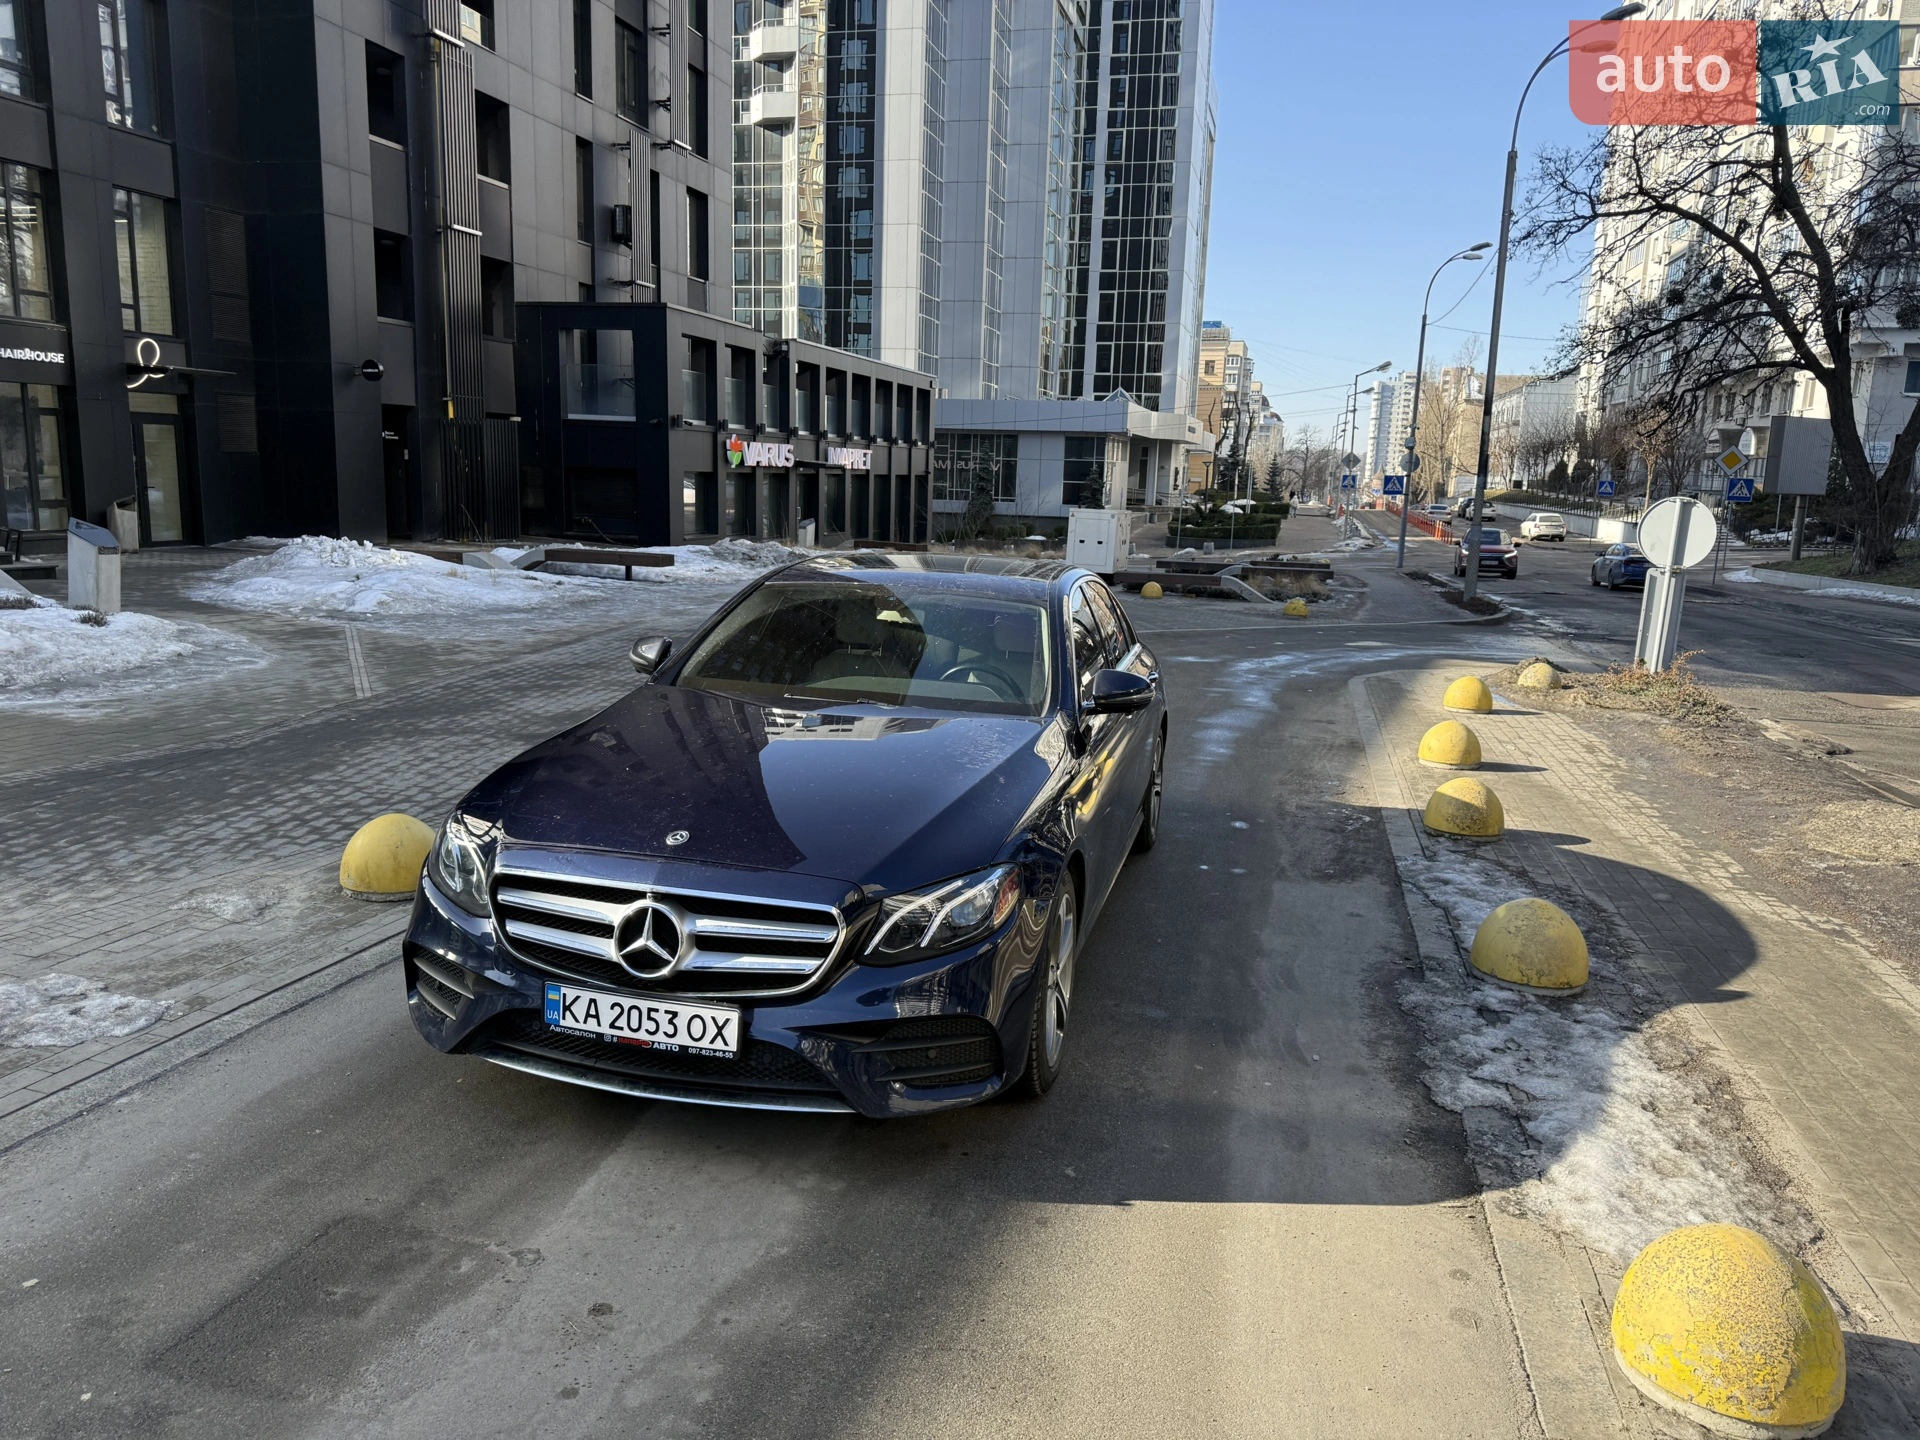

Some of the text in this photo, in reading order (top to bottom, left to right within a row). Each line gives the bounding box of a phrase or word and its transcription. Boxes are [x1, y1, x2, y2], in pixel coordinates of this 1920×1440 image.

[742, 441, 873, 470] VARUS MARKET
[547, 1009, 559, 1021] UA
[561, 992, 731, 1047] KA 2053 OX
[549, 1024, 596, 1039] Автосалон
[653, 1042, 679, 1052] АВТО
